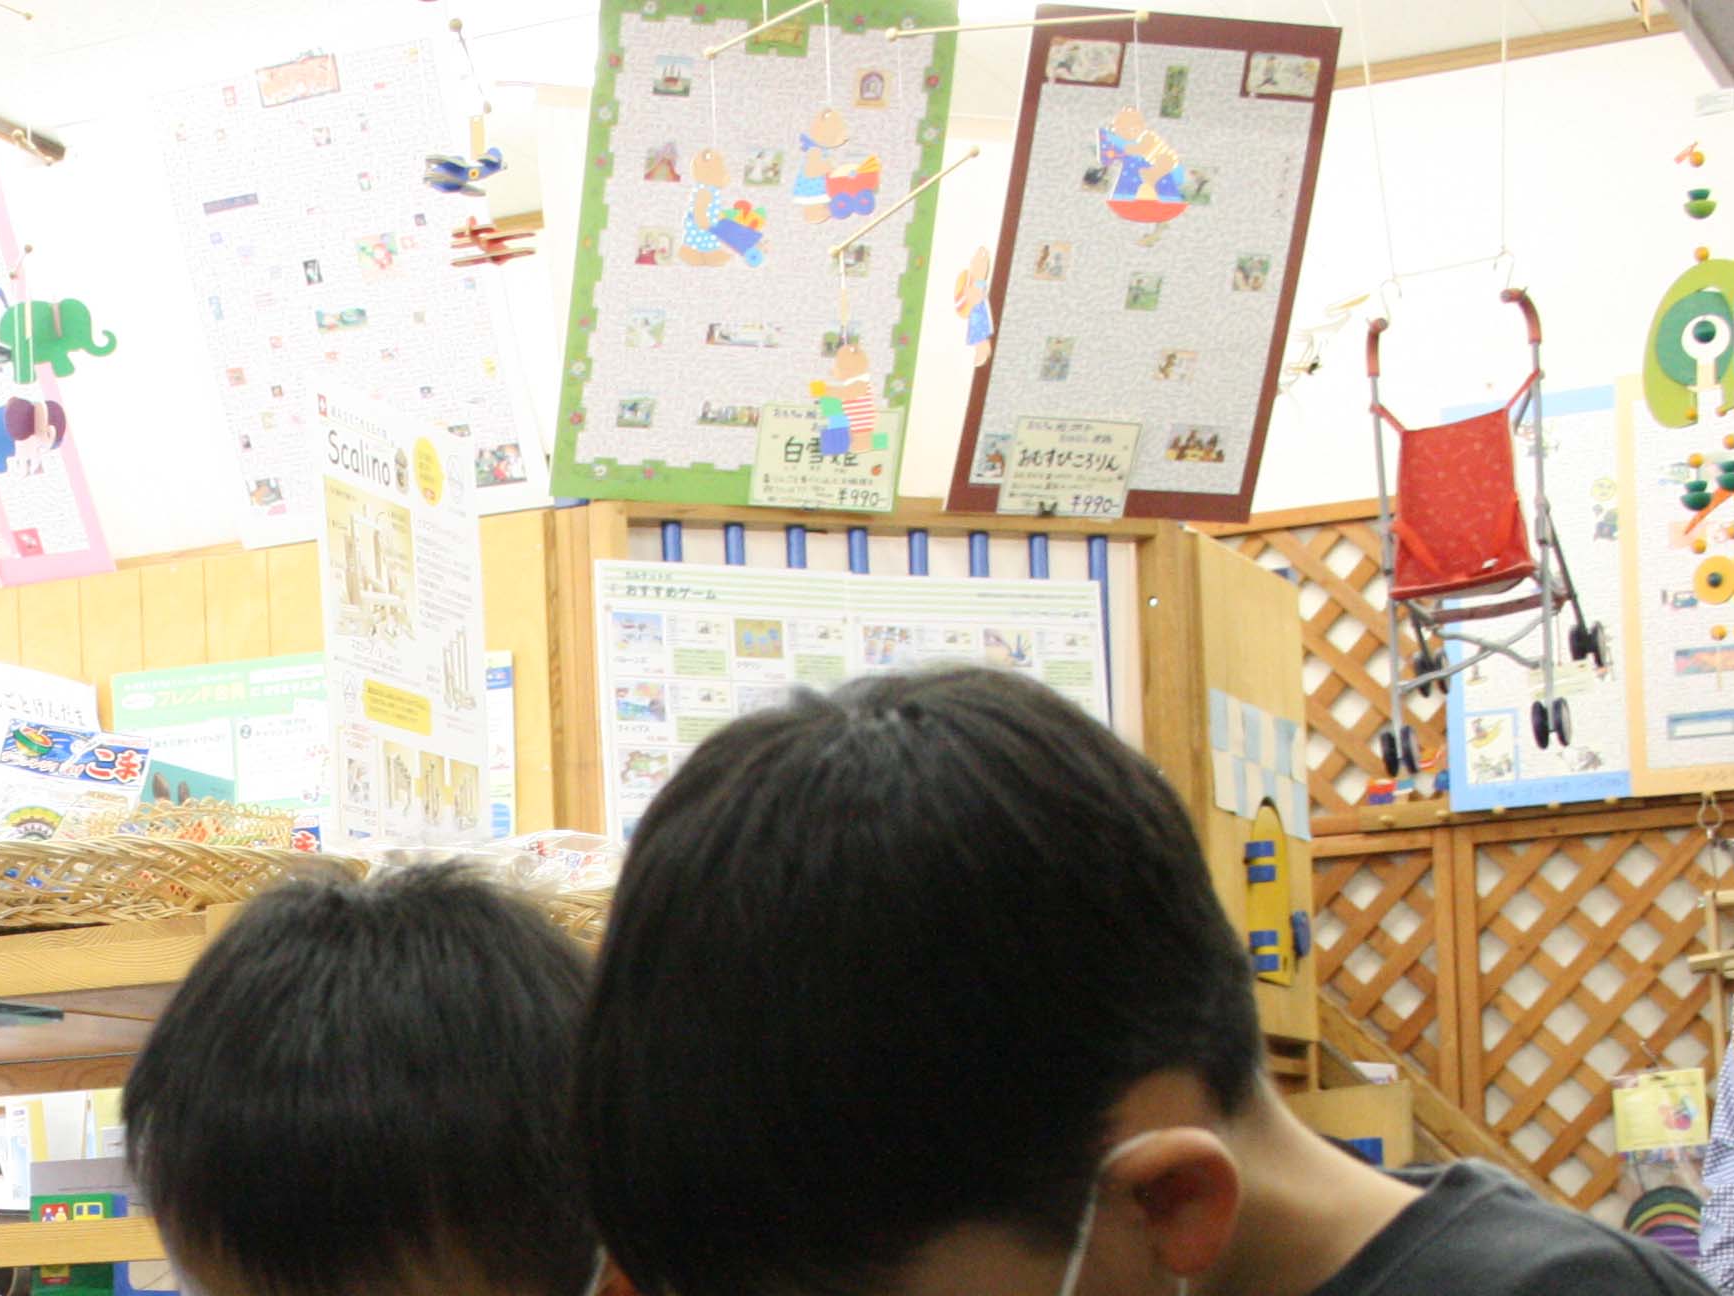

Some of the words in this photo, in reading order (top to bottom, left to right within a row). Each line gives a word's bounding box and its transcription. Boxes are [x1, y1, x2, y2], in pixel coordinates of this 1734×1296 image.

[327, 429, 392, 487] Scalino
[1017, 447, 1122, 472] おむすびころりん
[625, 584, 717, 600] おすすめゲーム
[86, 748, 142, 784] こま
